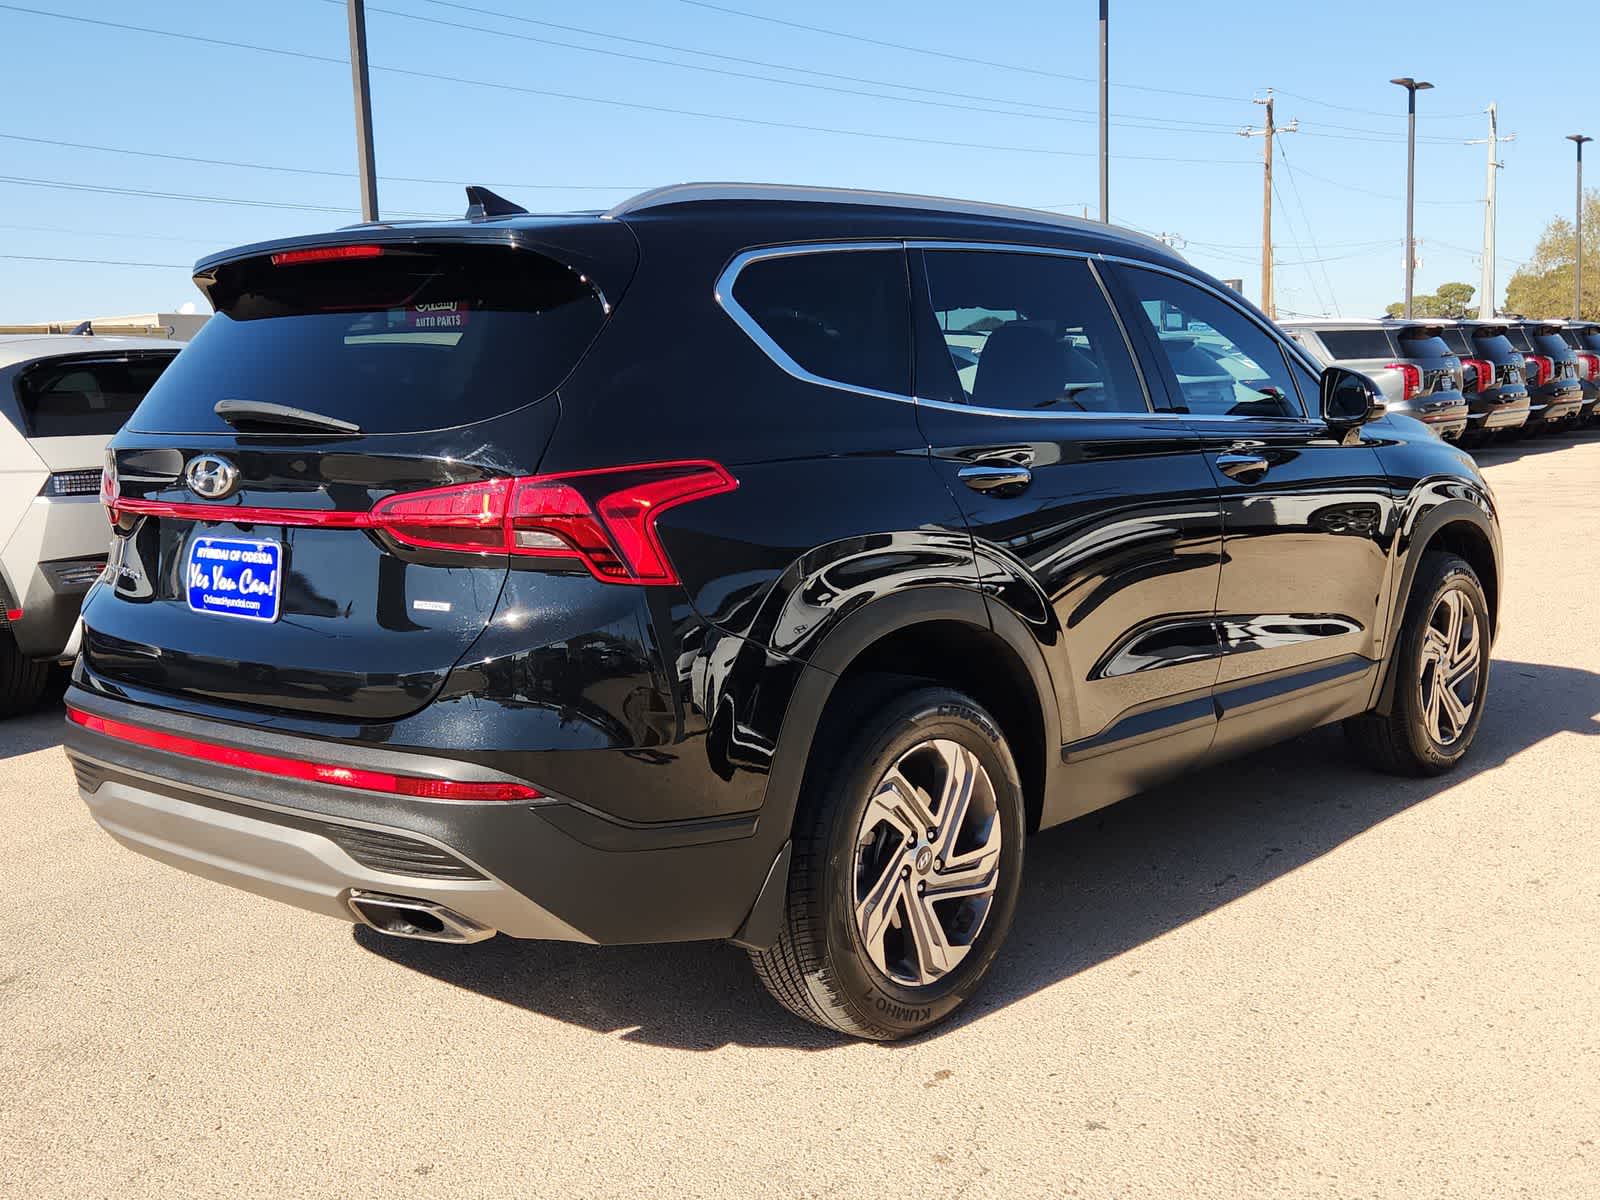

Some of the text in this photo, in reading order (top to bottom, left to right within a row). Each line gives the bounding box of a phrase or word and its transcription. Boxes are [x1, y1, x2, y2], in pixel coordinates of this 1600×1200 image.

[415, 315, 461, 327] AUTO PARTS
[197, 548, 273, 564] HYUNDAI OF ODESSA
[190, 563, 276, 597] Yes You Can!
[203, 594, 261, 610] OdessaHyundai.com
[875, 998, 932, 1022] KUMHO
